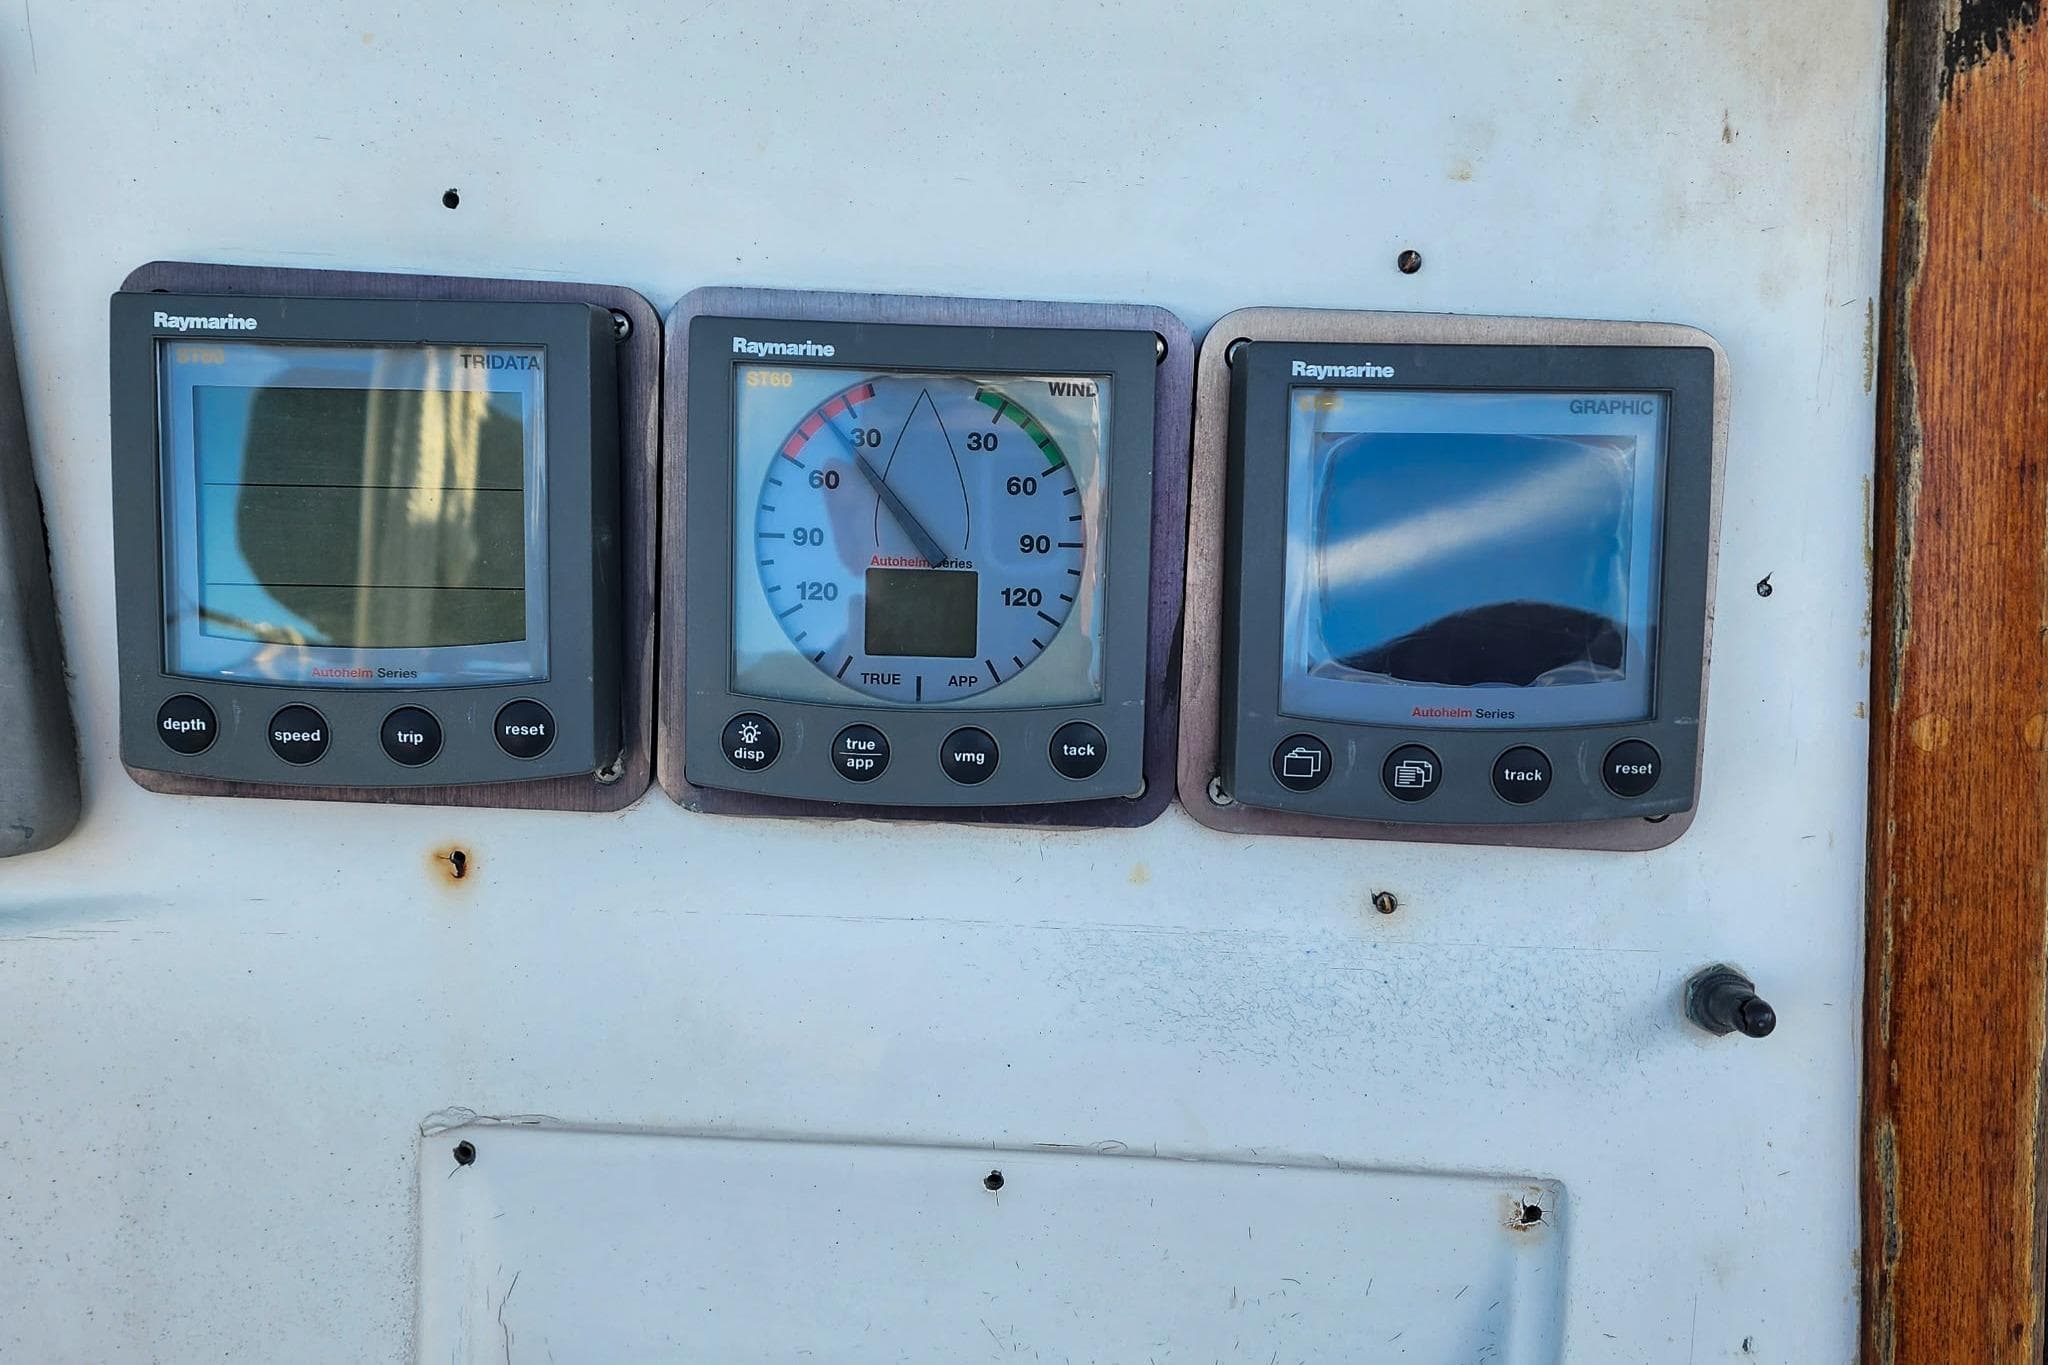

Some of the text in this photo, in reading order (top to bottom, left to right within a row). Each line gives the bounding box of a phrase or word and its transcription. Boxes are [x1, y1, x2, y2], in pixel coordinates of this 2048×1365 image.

[153, 311, 258, 331] Raymarine
[732, 336, 836, 357] Raymarine
[460, 354, 540, 370] TRIDATA
[1291, 360, 1395, 380] Raymarine
[746, 370, 793, 387] ST60
[1569, 399, 1654, 416] GRAPHIC
[850, 427, 882, 448] 30
[966, 432, 998, 452] 30
[808, 469, 840, 490] 60
[1006, 476, 1037, 496] 60
[792, 527, 825, 547] 90
[1019, 534, 1051, 554] 90
[937, 557, 973, 569] eries
[796, 581, 839, 601] 120
[1000, 587, 1043, 607] 120
[311, 667, 418, 679] Autohelm Series
[860, 673, 901, 686] TRUE
[948, 675, 979, 687] APP
[1411, 706, 1516, 720] Autohelm Series
[163, 717, 207, 733] depth
[505, 723, 545, 736] reset
[274, 729, 321, 744] speed
[396, 730, 424, 746] trip
[846, 737, 876, 751] true
[733, 747, 765, 763] disp
[1063, 743, 1096, 756] tack
[846, 757, 875, 770] app
[953, 752, 986, 765] vmg
[1504, 768, 1543, 782] track
[1614, 762, 1653, 775] reset
